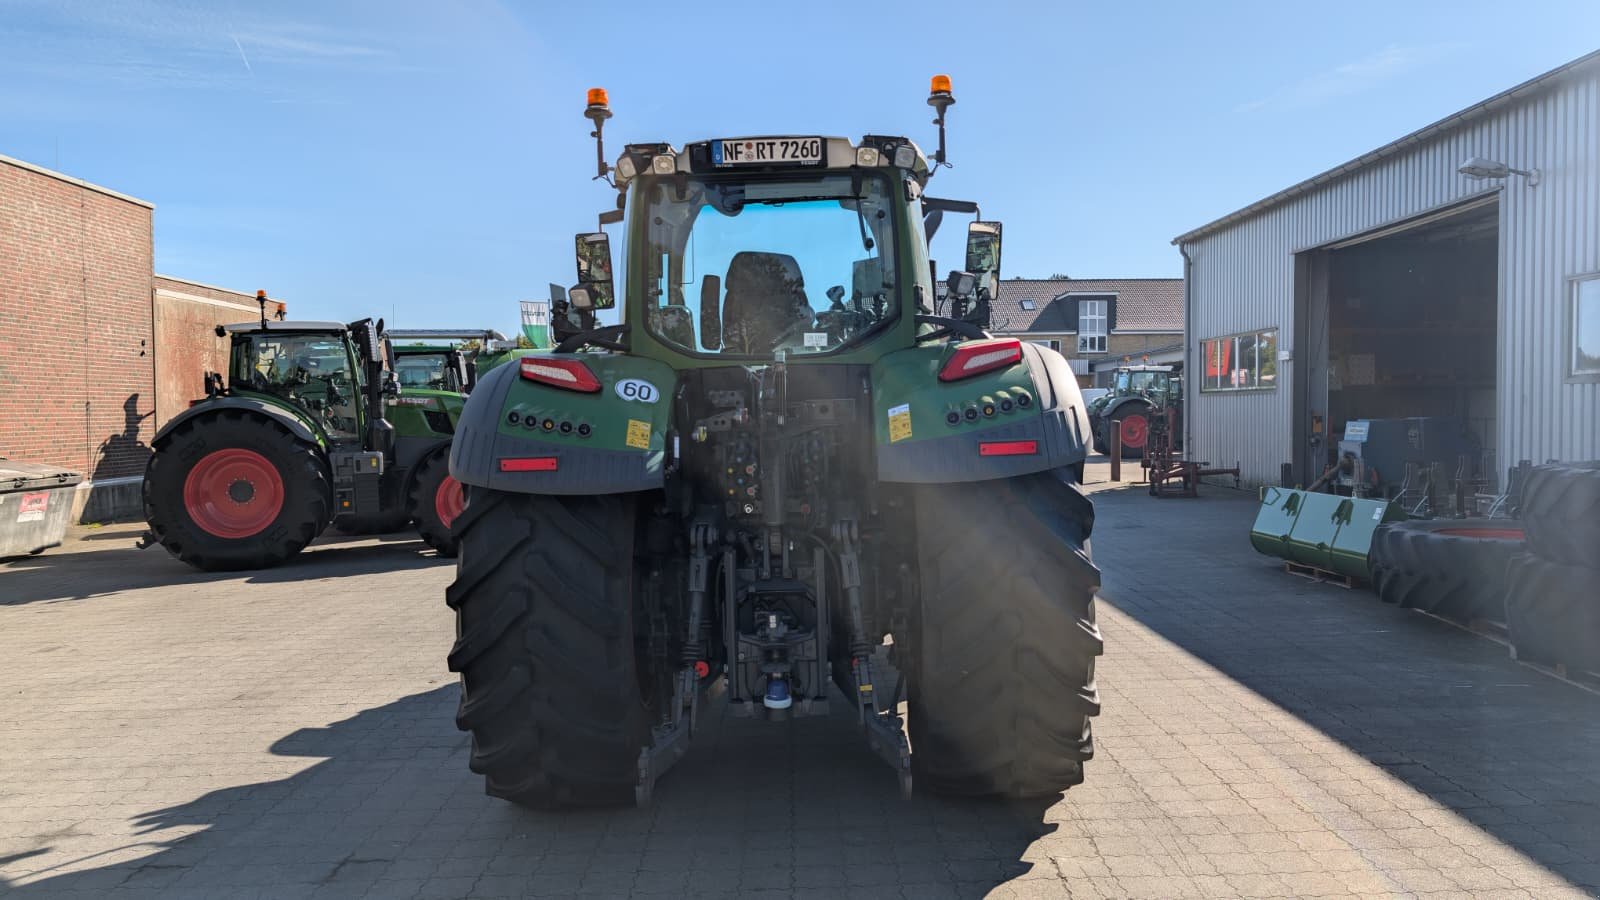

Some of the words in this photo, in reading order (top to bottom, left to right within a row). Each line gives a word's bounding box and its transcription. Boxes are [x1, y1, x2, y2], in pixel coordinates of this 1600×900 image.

[723, 142, 743, 160] NF
[756, 141, 776, 160] RT
[780, 140, 820, 159] 7260
[623, 382, 652, 400] 60
